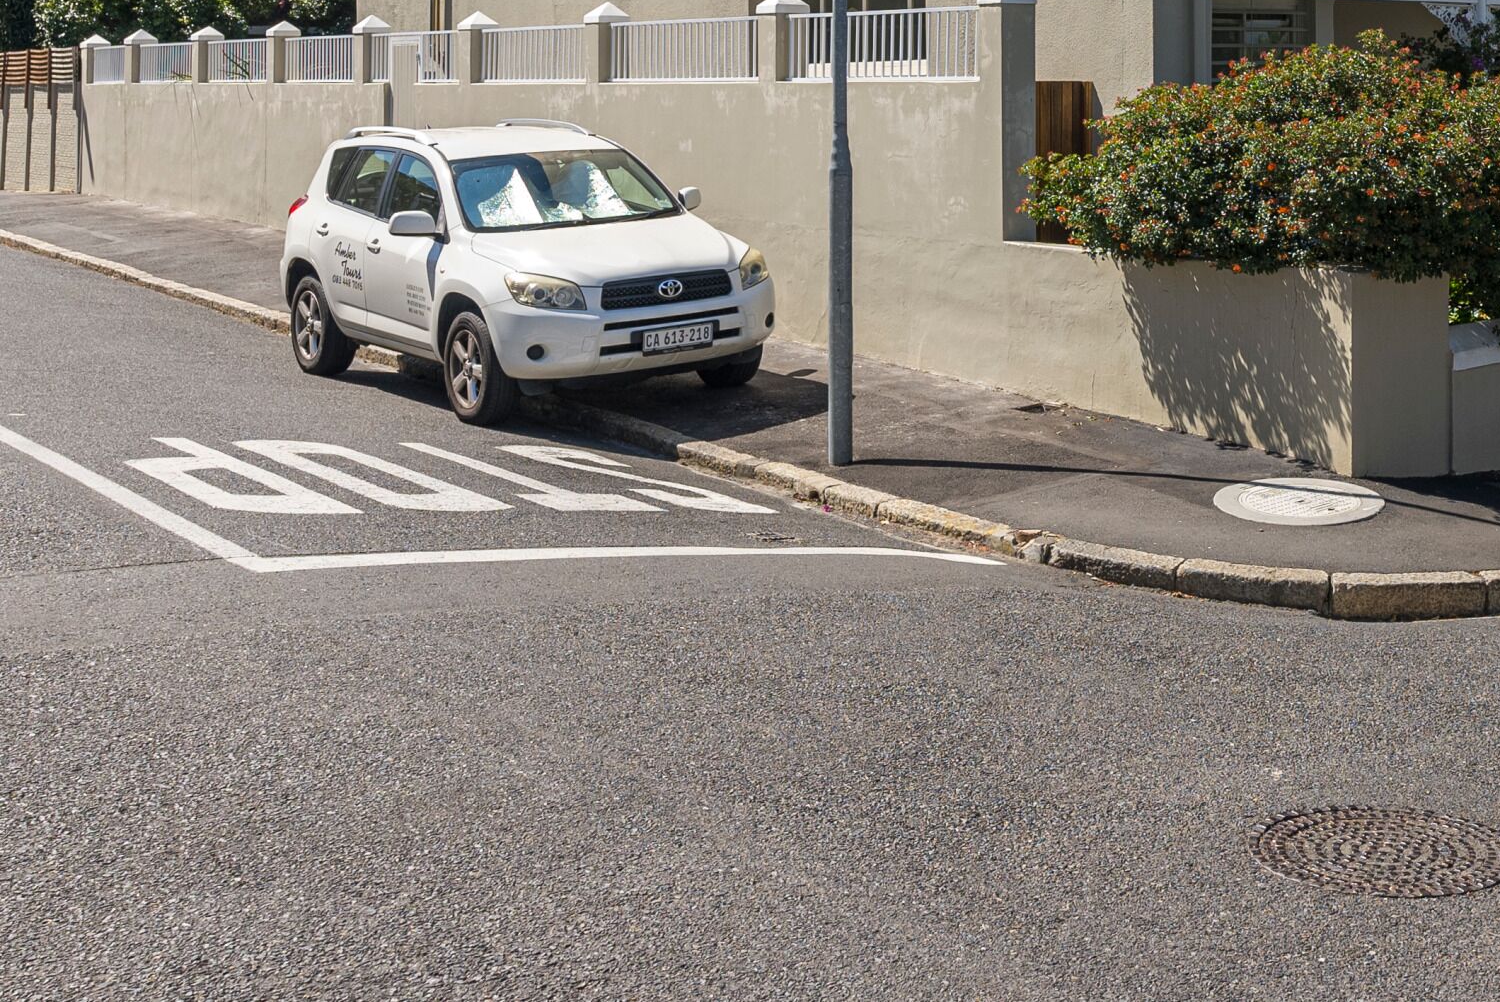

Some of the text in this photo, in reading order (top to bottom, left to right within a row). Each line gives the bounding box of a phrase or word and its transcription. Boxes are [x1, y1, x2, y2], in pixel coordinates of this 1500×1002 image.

[334, 241, 356, 261] Amber
[341, 260, 362, 280] Tours
[646, 326, 710, 348] CA 613-218
[124, 436, 780, 515] STOP
